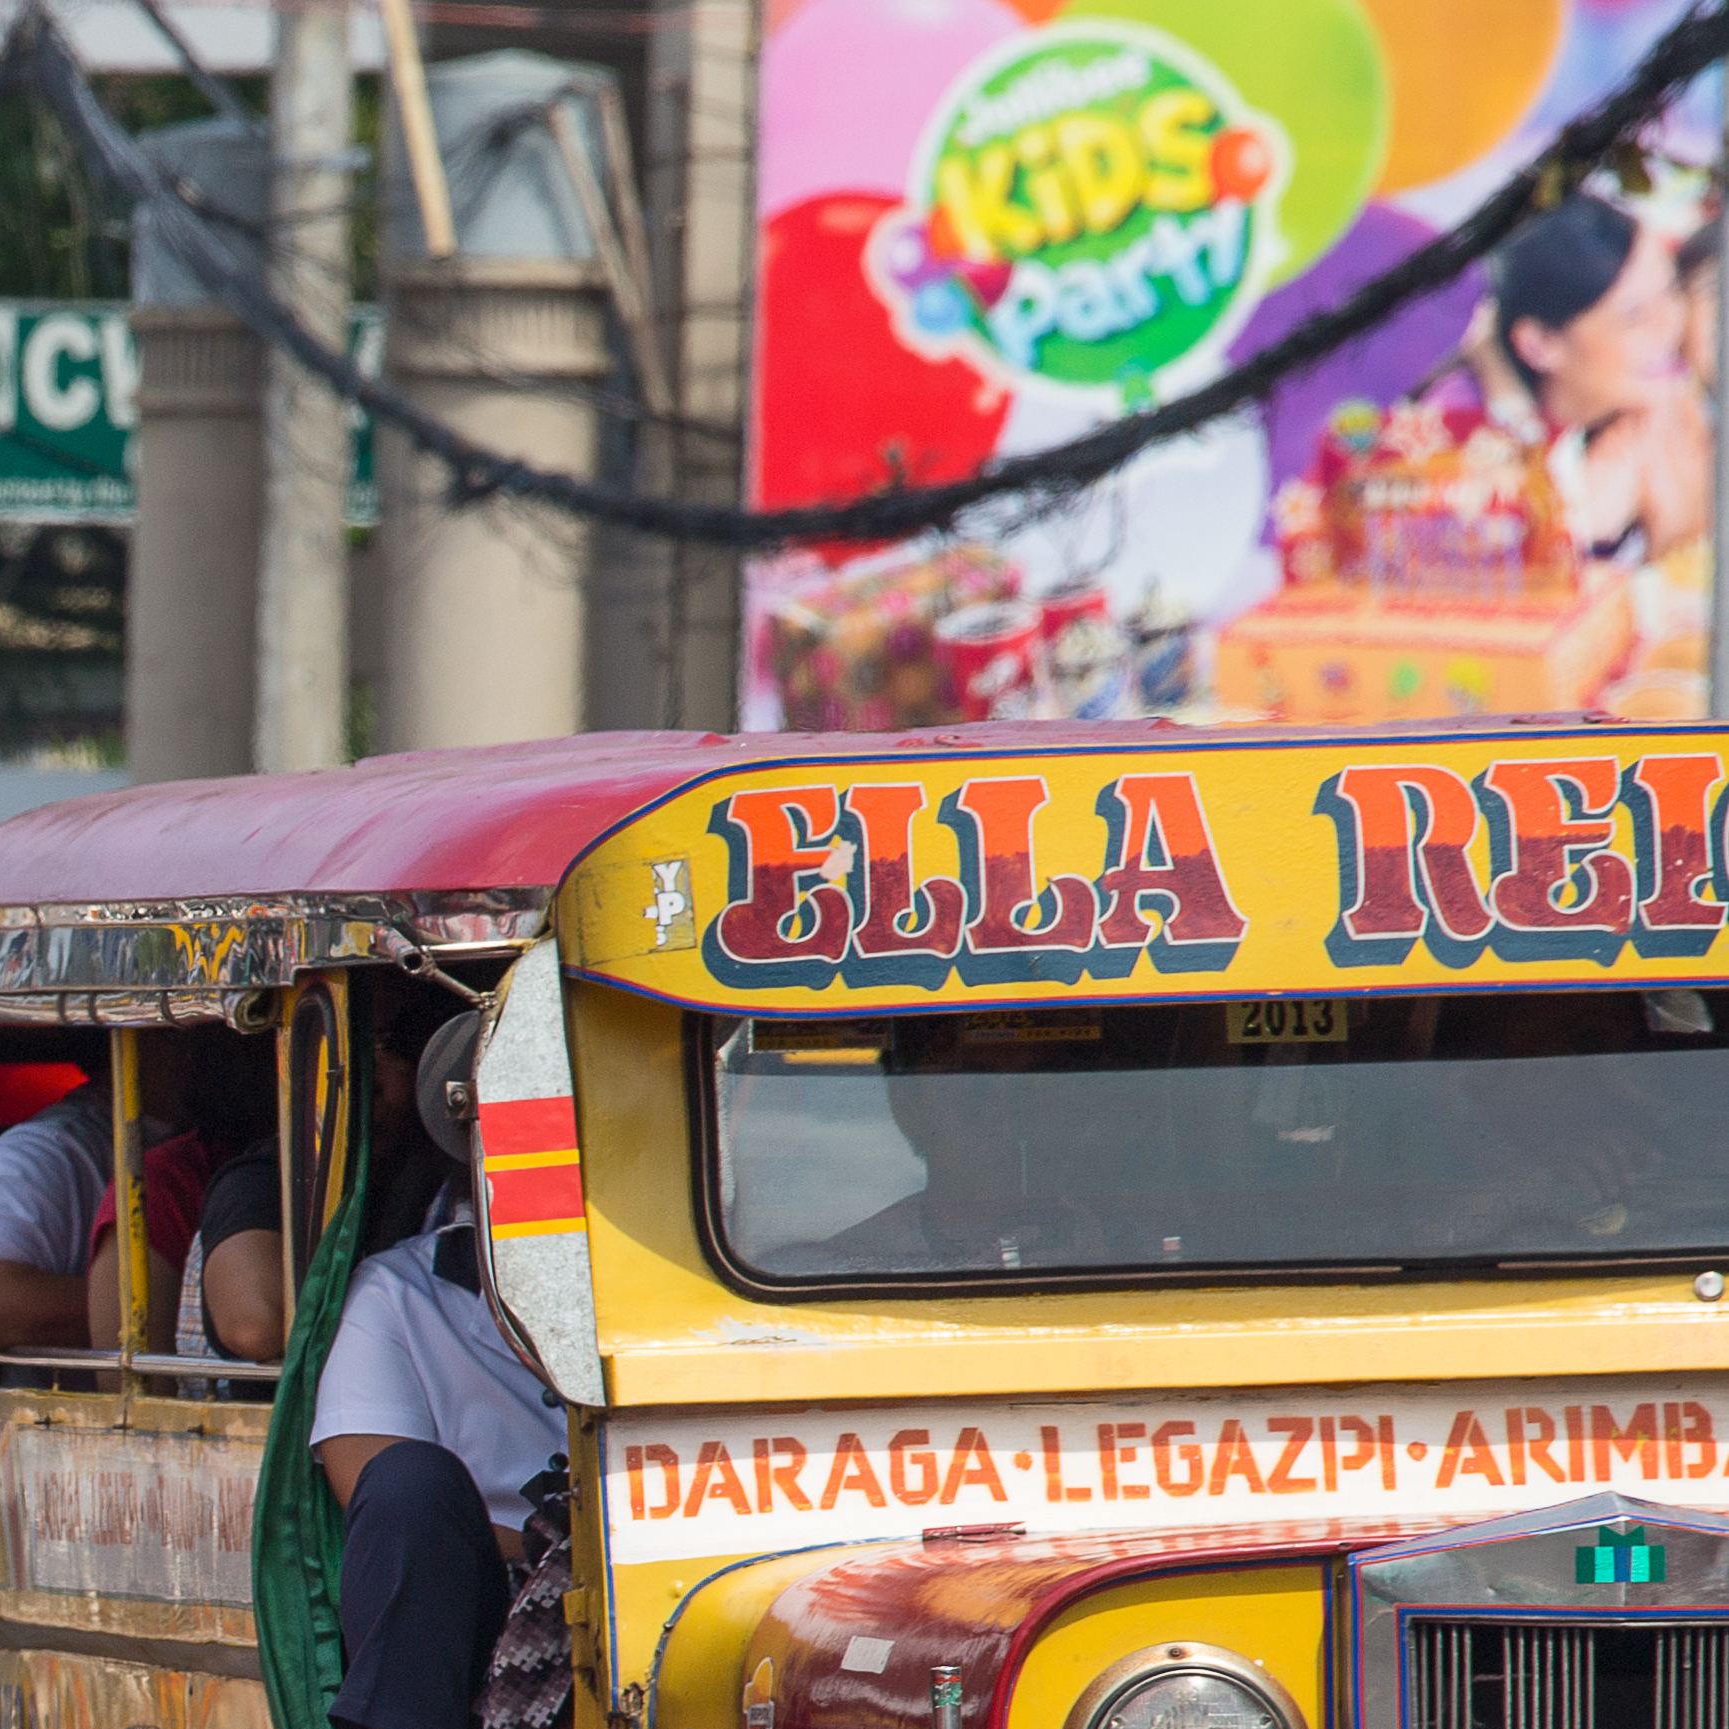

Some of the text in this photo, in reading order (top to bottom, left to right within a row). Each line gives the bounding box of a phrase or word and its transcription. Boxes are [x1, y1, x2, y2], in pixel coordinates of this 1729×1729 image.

[704, 750, 1729, 990] ELLA REI
[1241, 1000, 1334, 1037] 2013
[626, 1401, 1729, 1522] DARAGA LEGAZPI ARIMB
